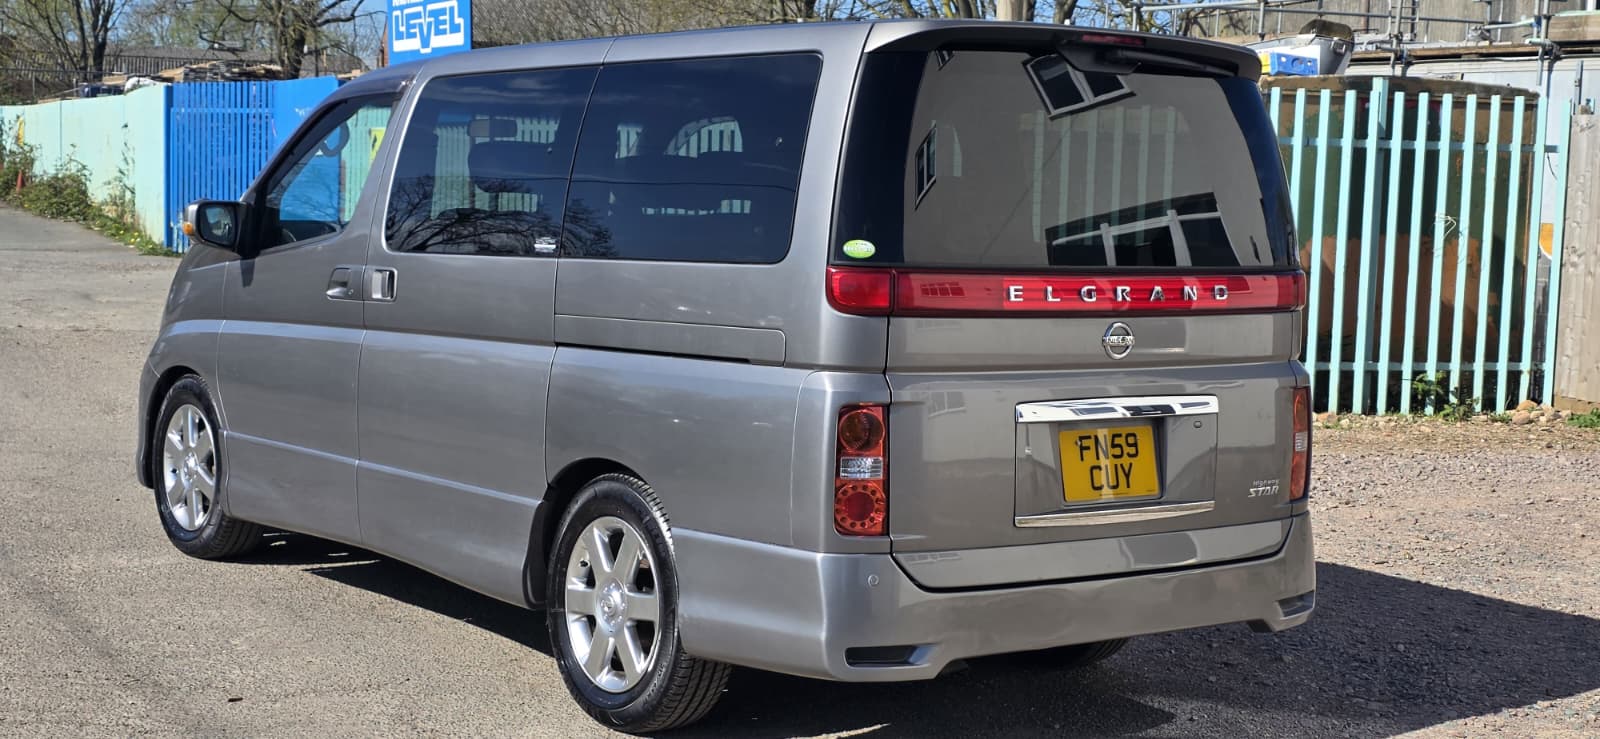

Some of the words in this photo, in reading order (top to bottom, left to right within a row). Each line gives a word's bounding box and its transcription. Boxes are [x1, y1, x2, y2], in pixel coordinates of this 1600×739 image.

[393, 3, 463, 52] LEVEL
[1008, 284, 1229, 303] ELGRAND
[1077, 432, 1139, 461] FN59
[1089, 462, 1133, 491] CUY
[1247, 485, 1279, 497] STAR
